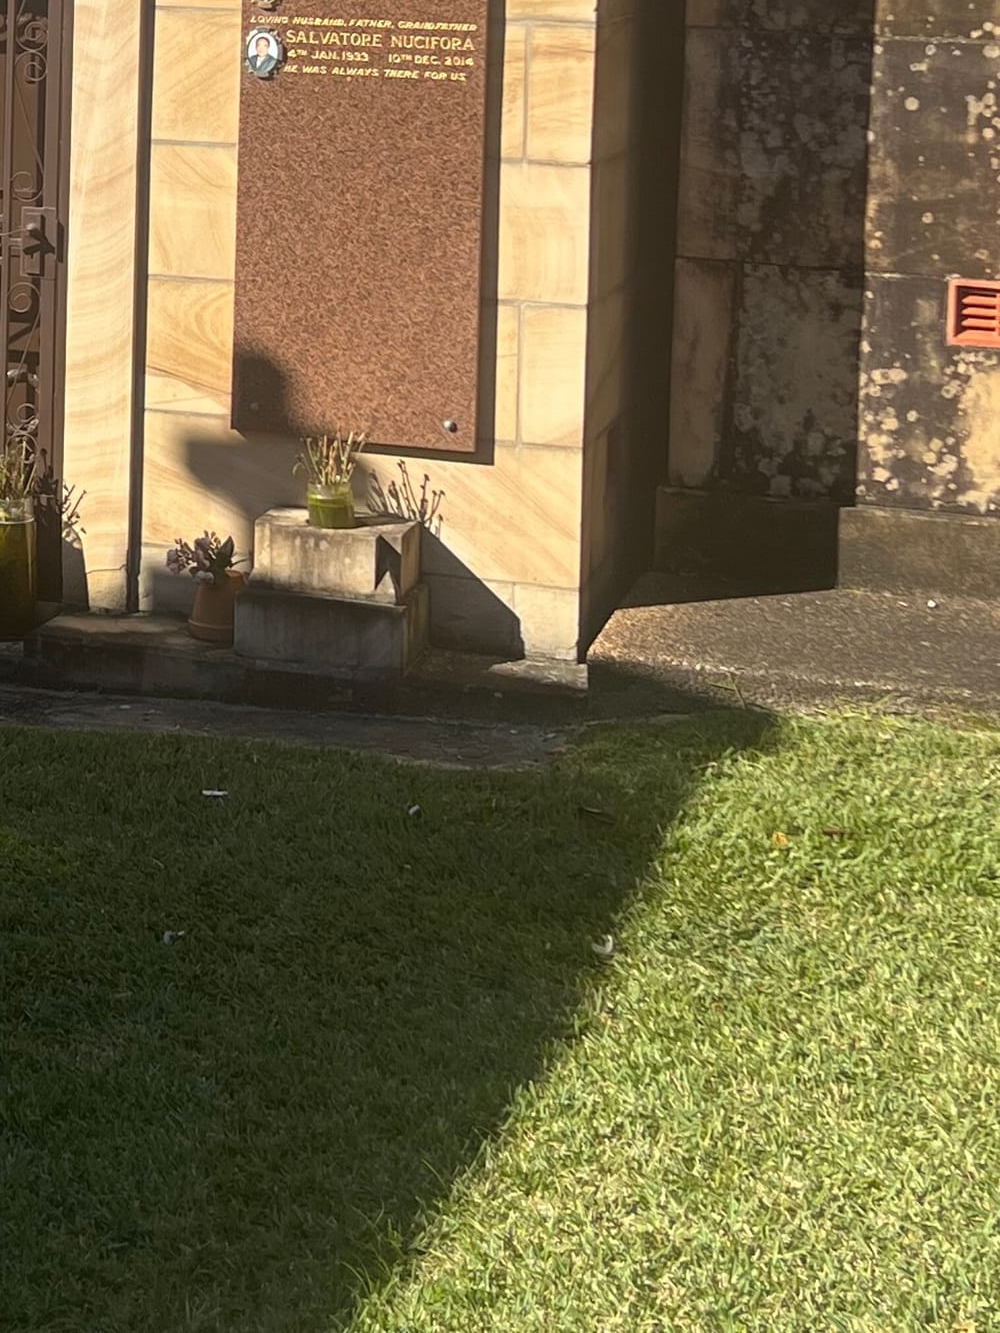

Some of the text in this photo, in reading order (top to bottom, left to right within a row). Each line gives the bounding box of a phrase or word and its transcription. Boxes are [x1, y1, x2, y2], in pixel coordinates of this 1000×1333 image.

[250, 16, 288, 24] LOVING
[398, 21, 477, 32] GRANDFATHER
[286, 29, 475, 51] SALVATORE NUCIFORA
[444, 56, 474, 66] 2014
[283, 65, 467, 82] HE WAS ALWAYS THERE FOR US
